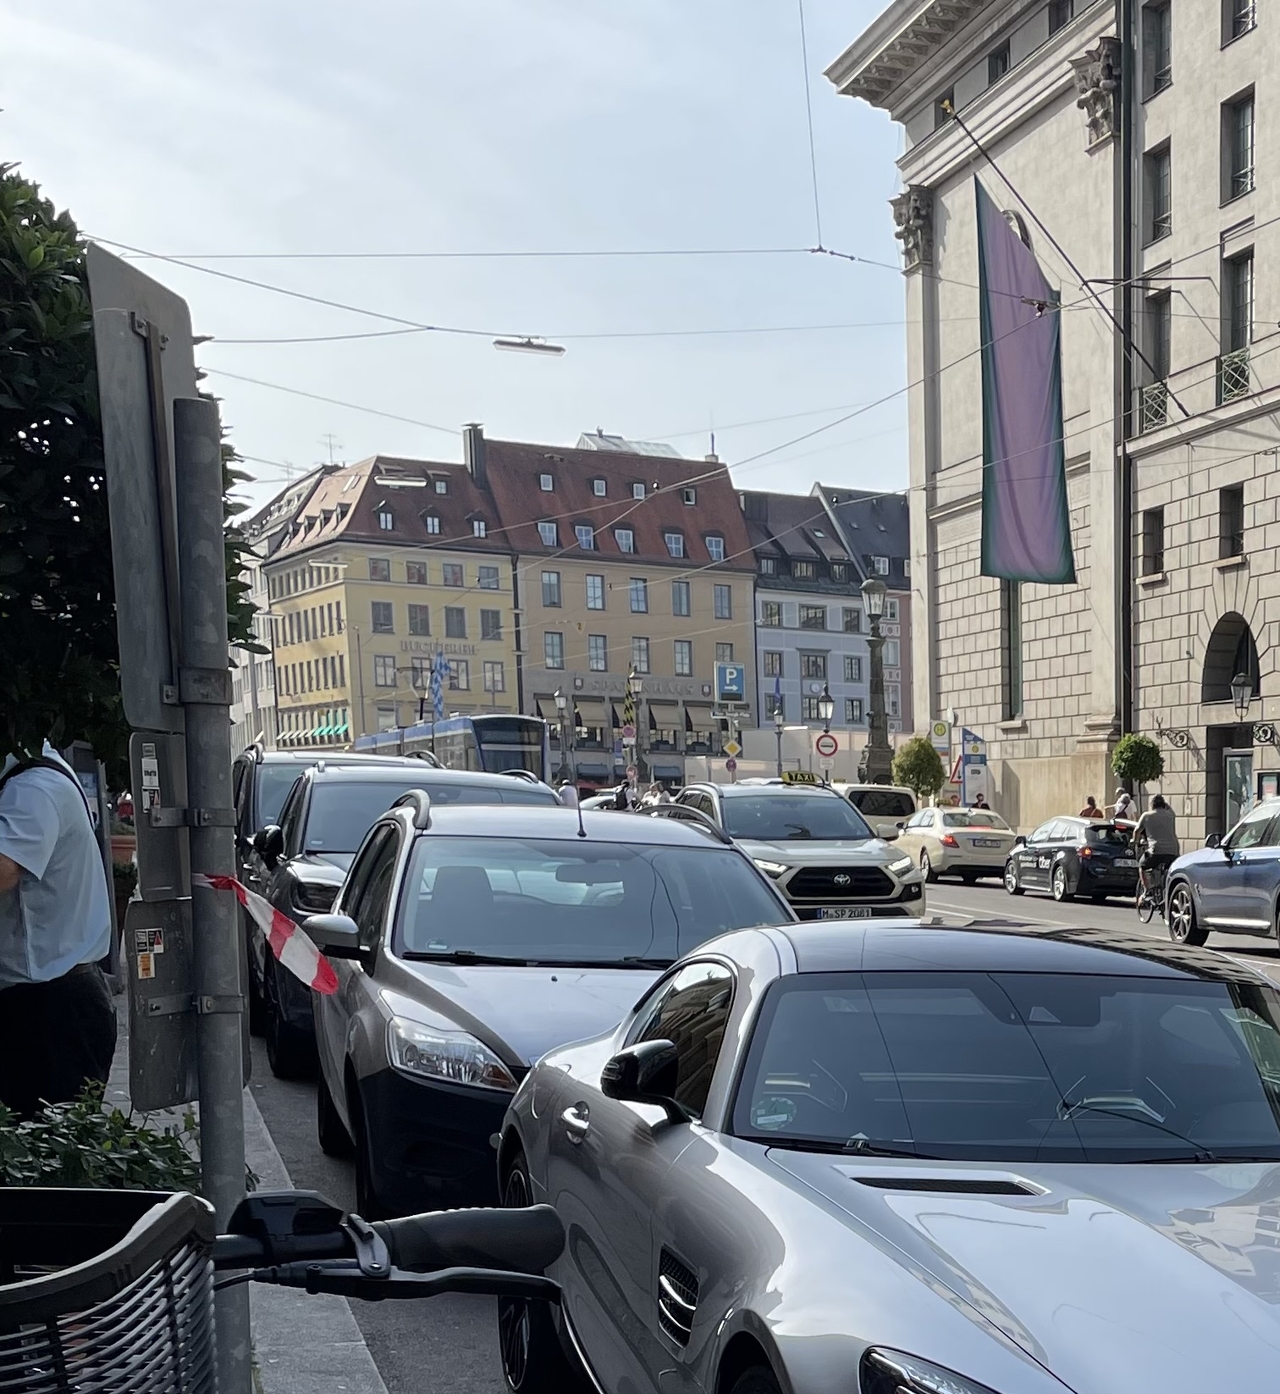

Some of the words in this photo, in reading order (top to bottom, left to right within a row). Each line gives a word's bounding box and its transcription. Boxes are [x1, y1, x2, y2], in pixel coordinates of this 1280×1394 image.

[725, 668, 737, 684] P
[591, 679, 695, 696] SPANHAUS
[822, 909, 829, 919] M
